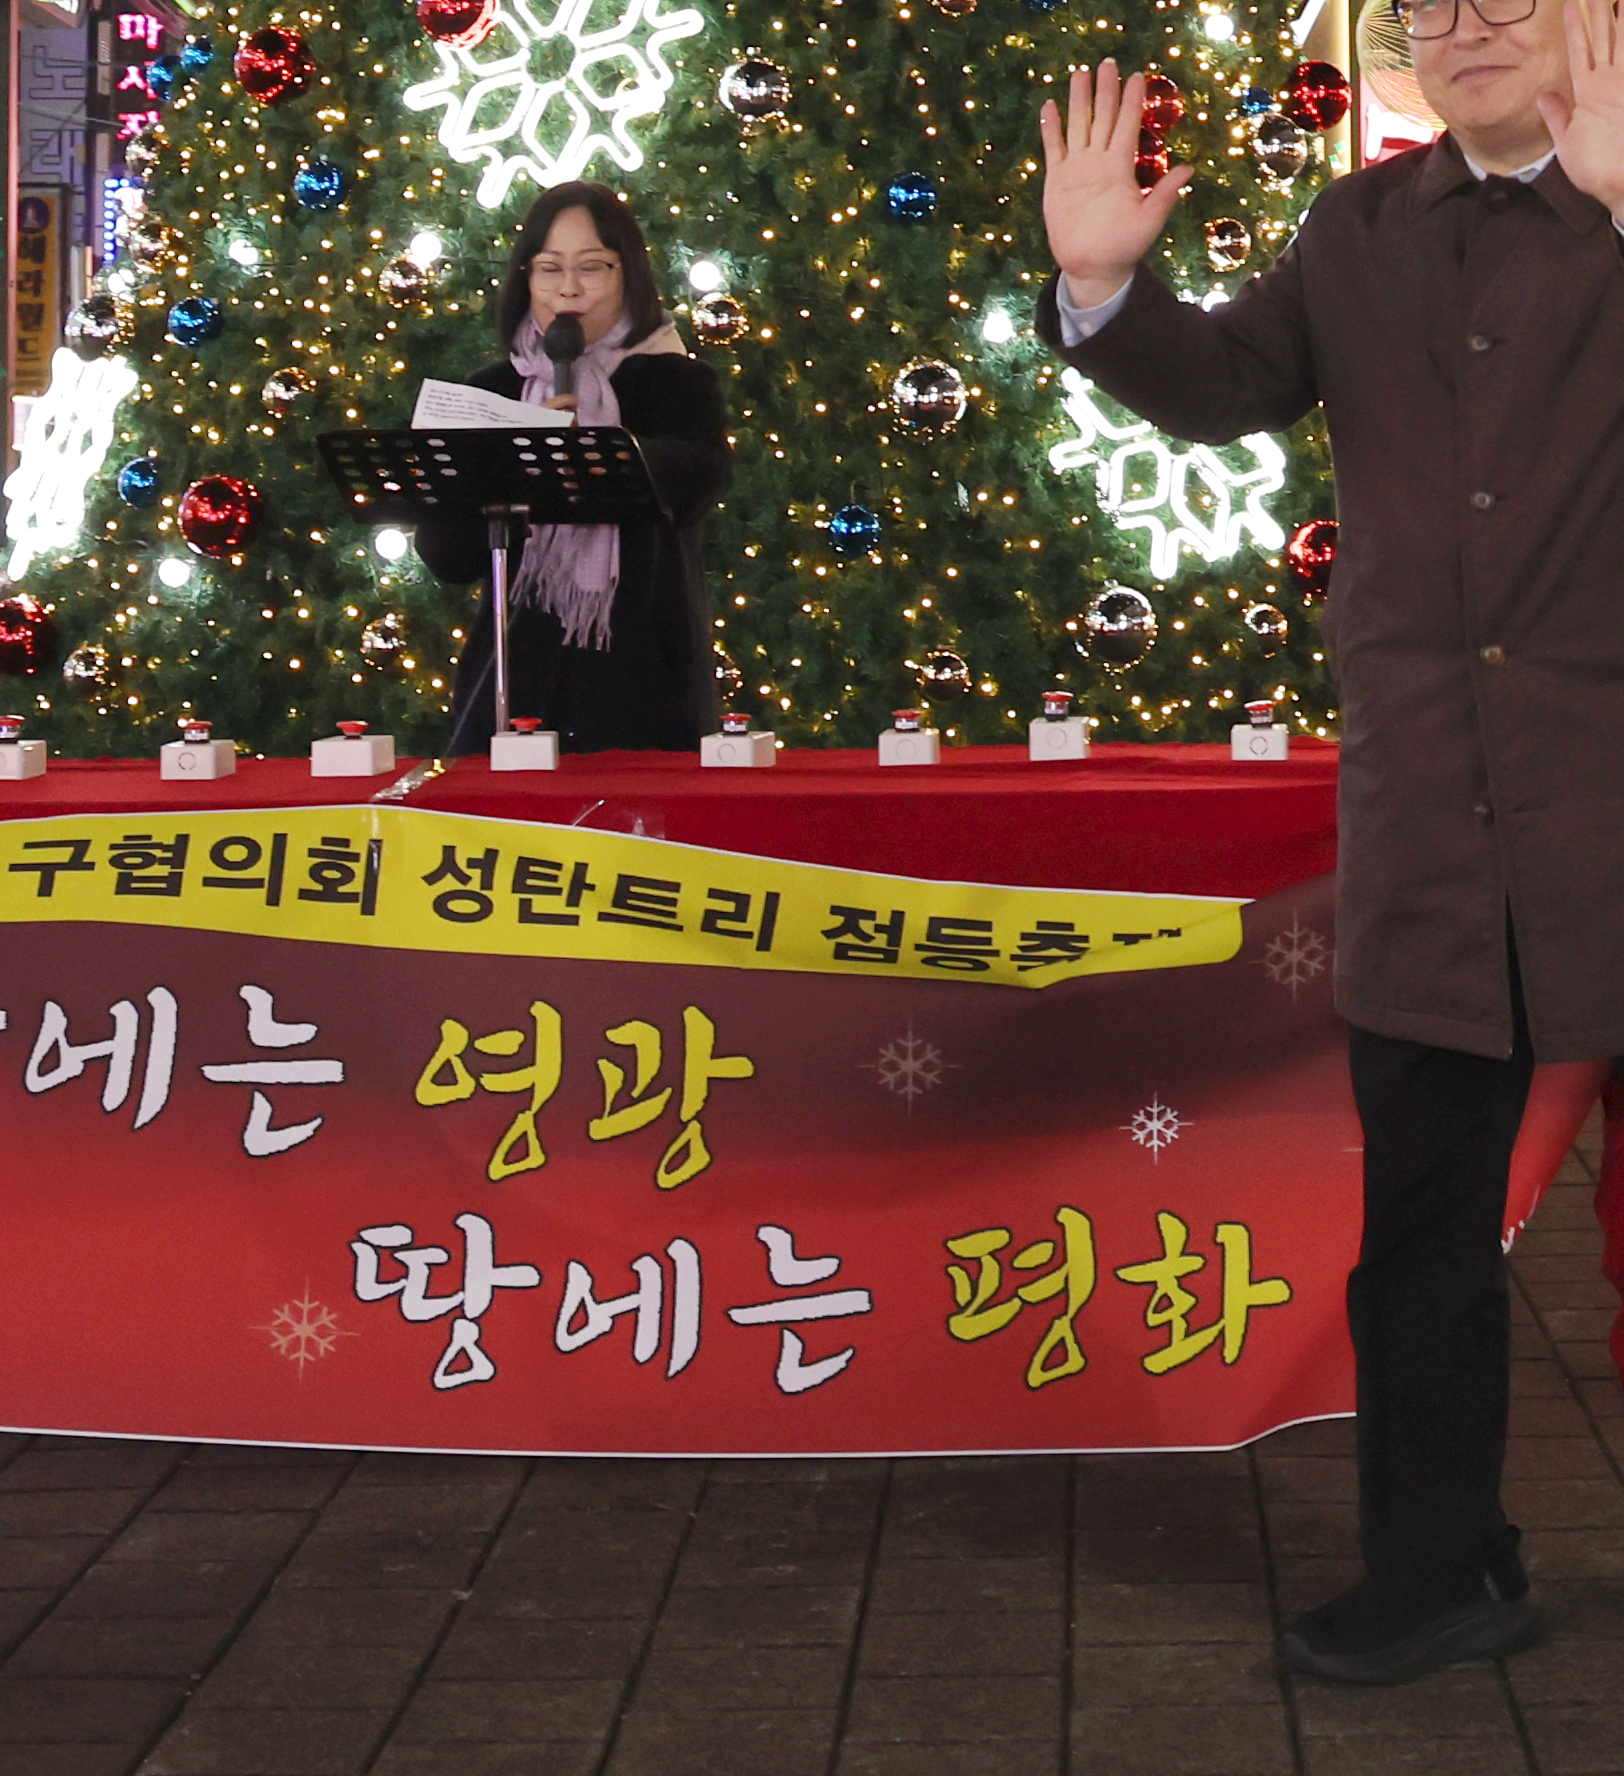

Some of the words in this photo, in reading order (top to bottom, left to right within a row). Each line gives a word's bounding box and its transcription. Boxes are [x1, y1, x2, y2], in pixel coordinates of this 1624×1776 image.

[420, 841, 780, 954] 성탄트리
[414, 1000, 755, 1190] 영광
[348, 1212, 874, 1394] 땅에는
[944, 1206, 1293, 1389] 평화
